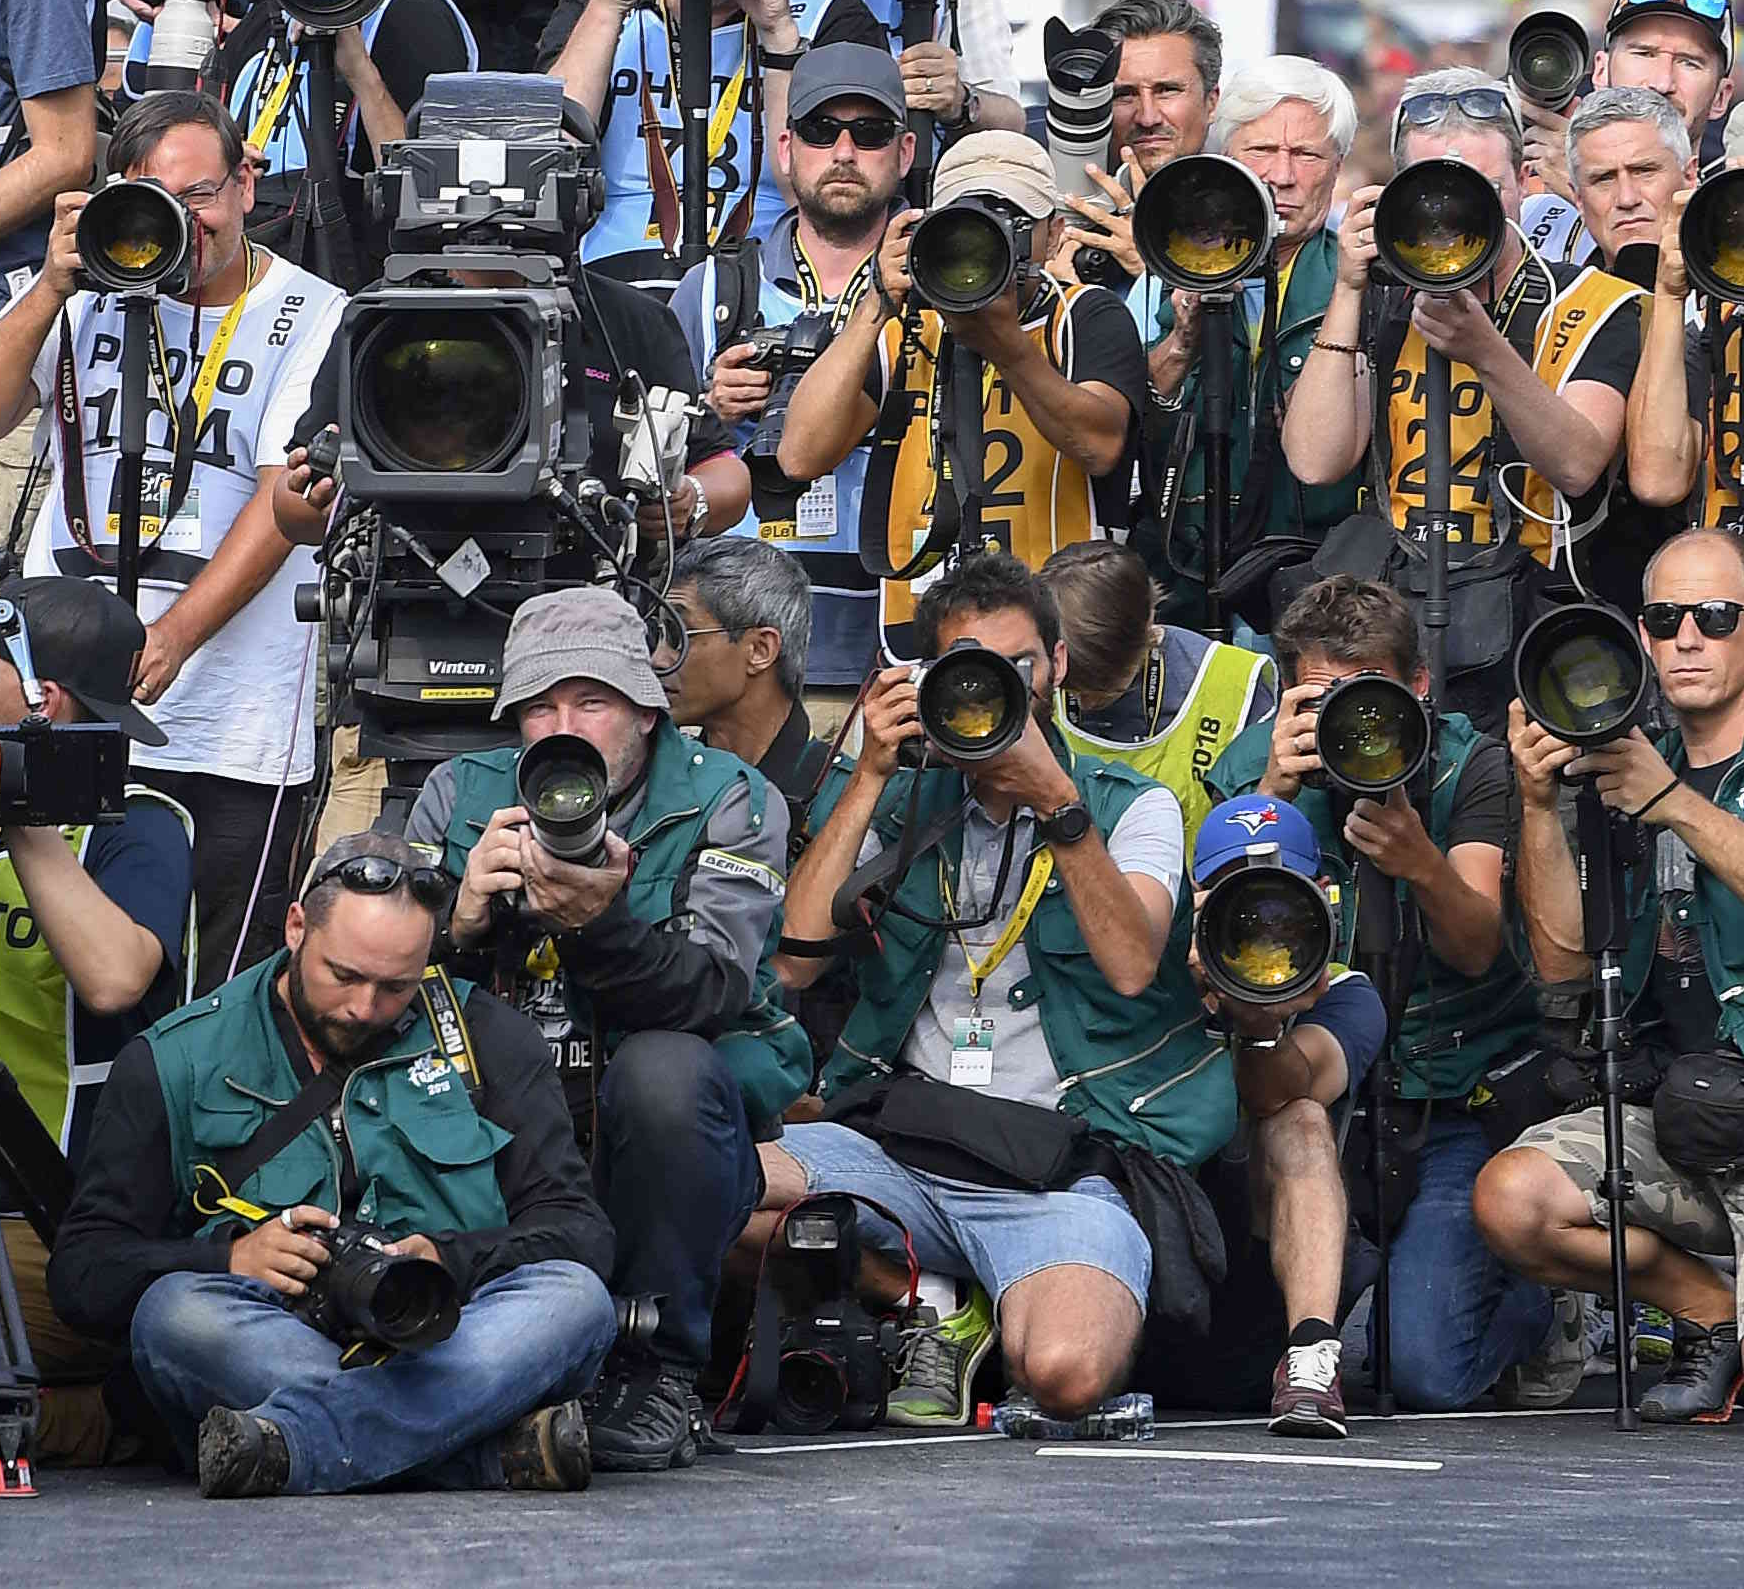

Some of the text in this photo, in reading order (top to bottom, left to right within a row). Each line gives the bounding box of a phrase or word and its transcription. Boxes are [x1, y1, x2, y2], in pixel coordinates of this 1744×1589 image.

[1529, 207, 1566, 250] 2018
[267, 294, 306, 348] 2018
[62, 357, 76, 424] Canon
[1160, 466, 1177, 518] Canon
[759, 522, 799, 540] @LeT
[428, 659, 487, 677] Vinten
[436, 1008, 467, 1057] NPS
